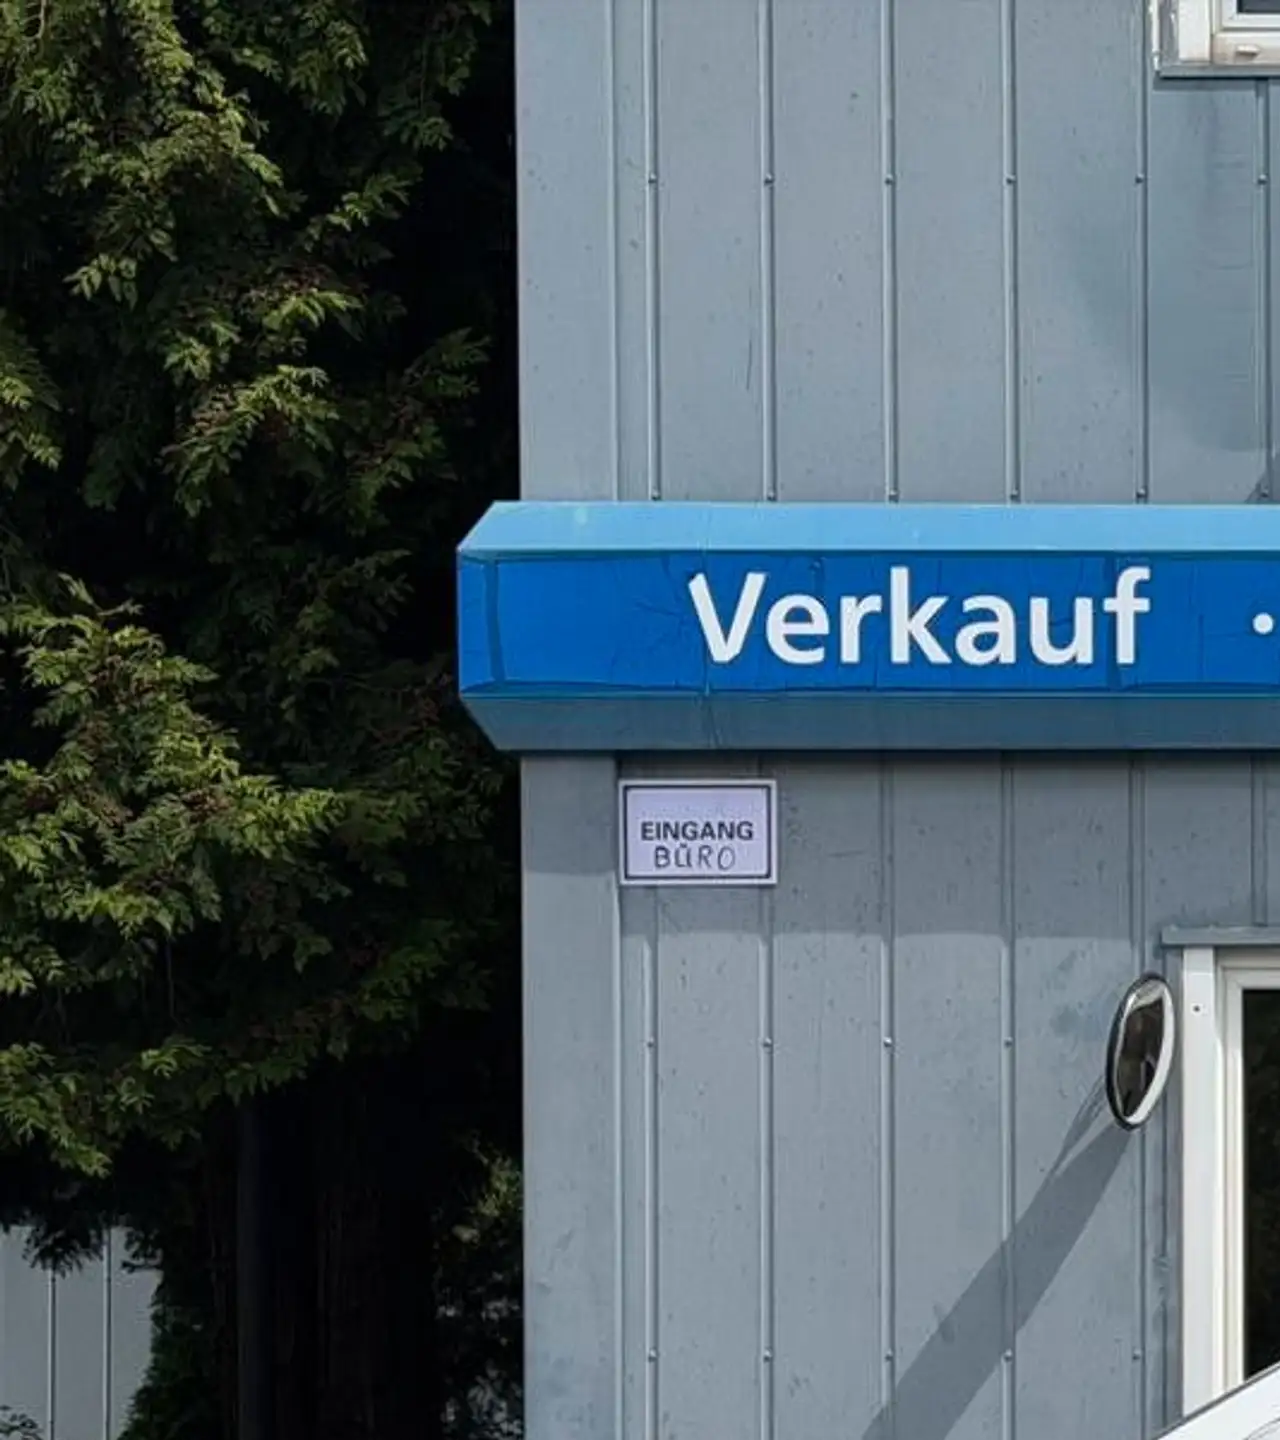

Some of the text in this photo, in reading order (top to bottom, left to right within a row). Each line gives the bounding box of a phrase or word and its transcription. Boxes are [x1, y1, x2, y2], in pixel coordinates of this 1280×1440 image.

[689, 566, 1151, 666] Verkauf
[640, 820, 754, 842] EINGANG
[654, 843, 736, 871] BÜRO
